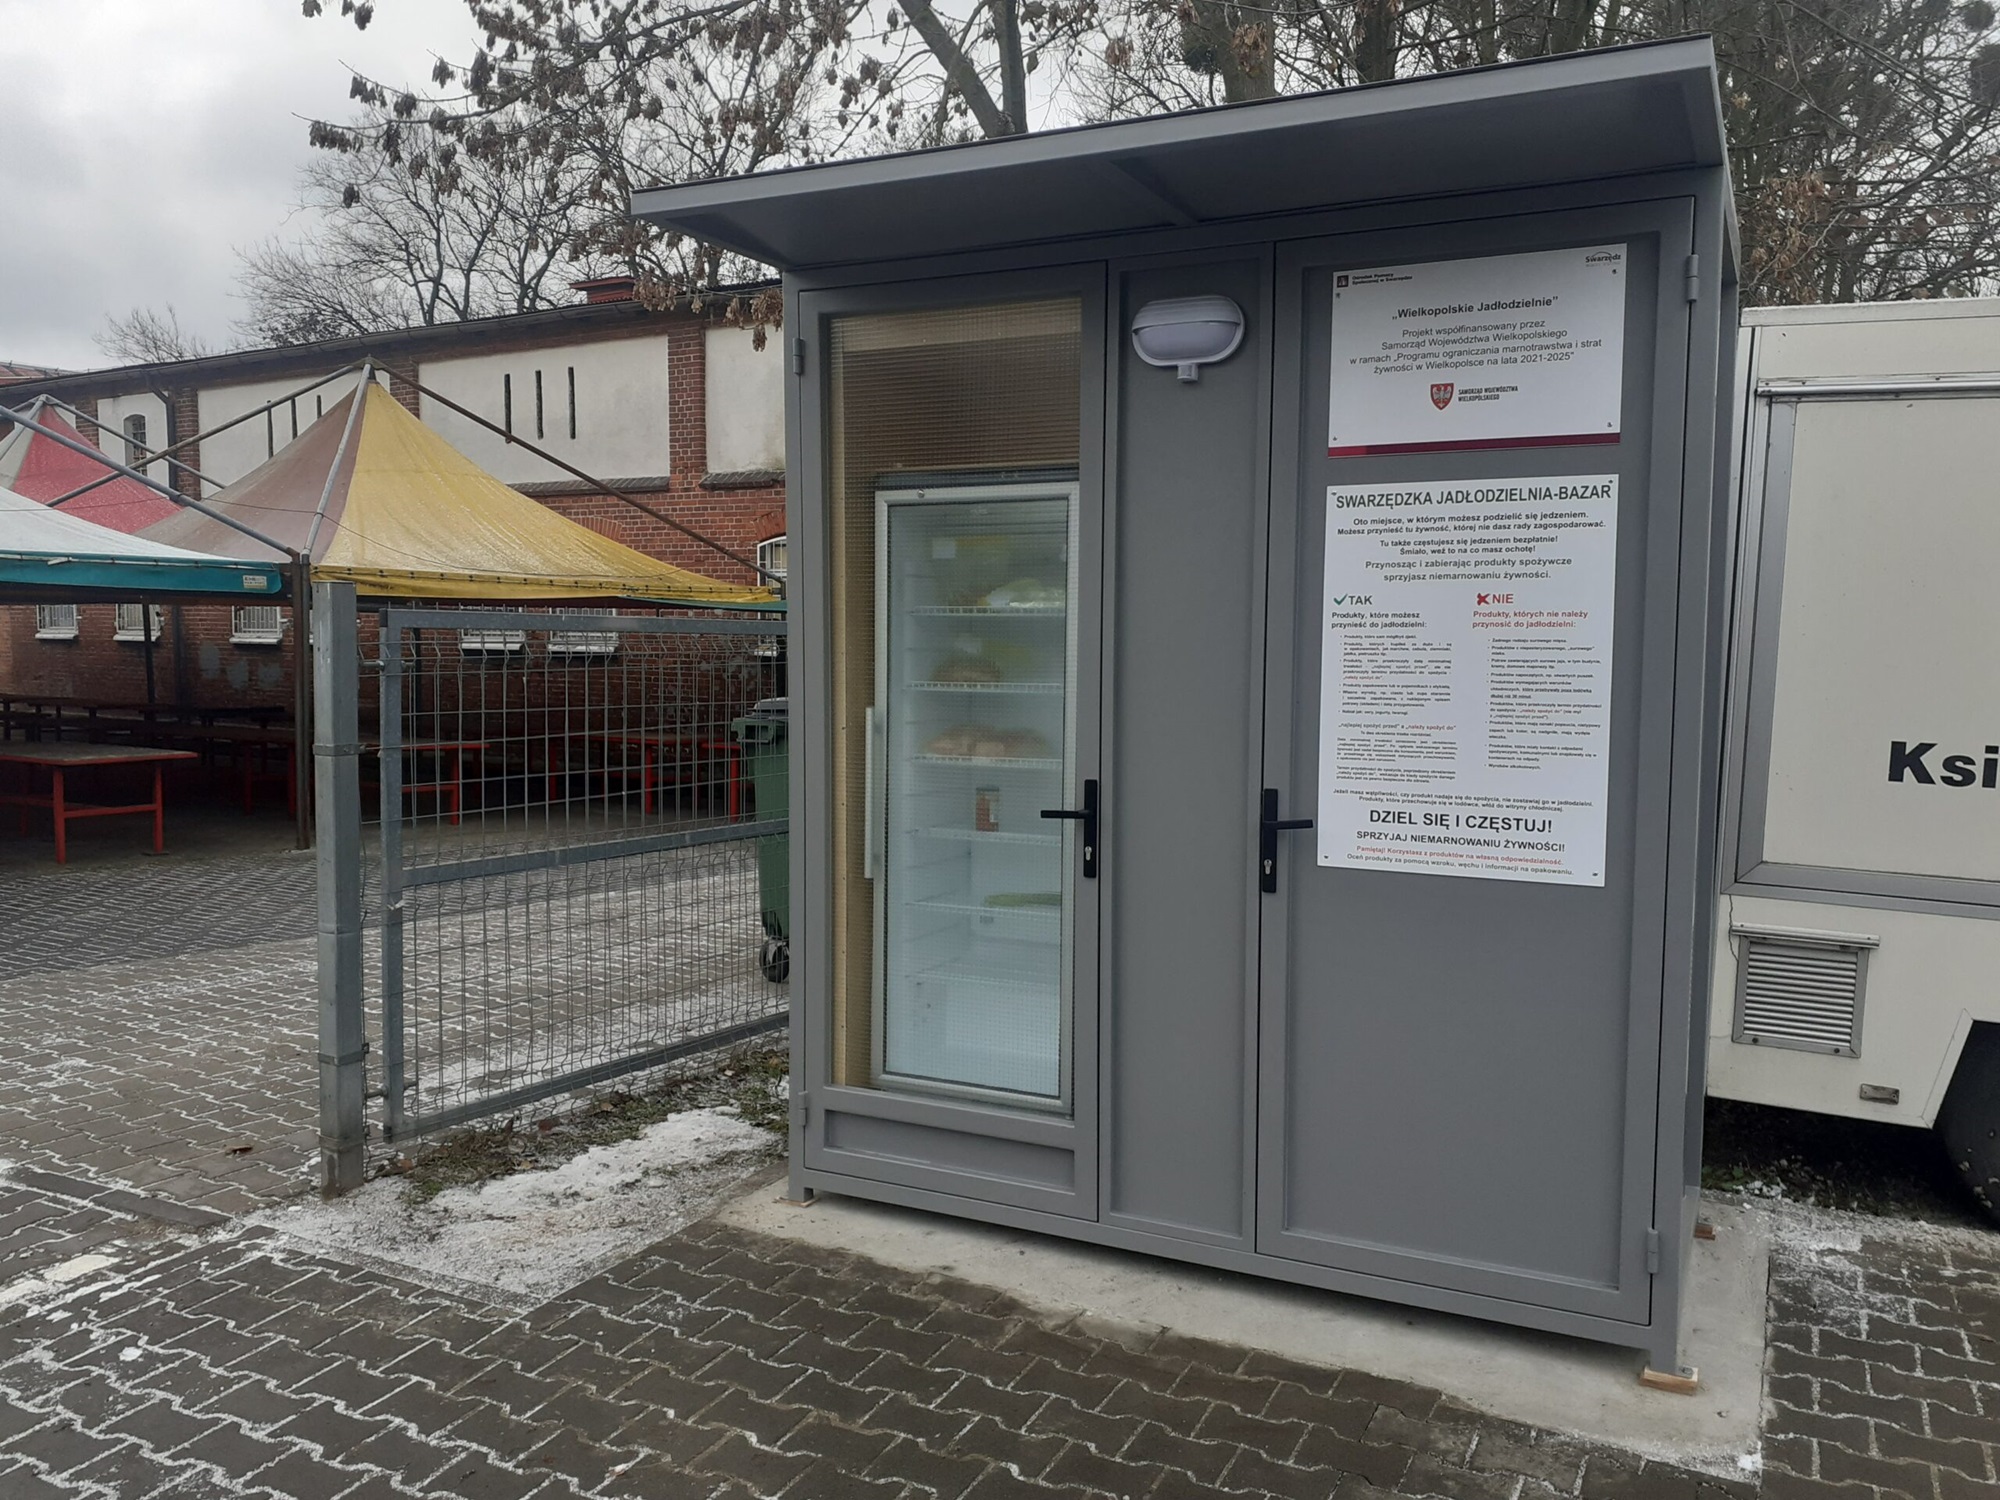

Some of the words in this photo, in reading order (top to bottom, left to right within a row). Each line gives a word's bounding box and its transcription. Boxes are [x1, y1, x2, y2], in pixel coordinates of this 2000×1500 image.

[1585, 252, 1621, 263] Swarzędz
[1477, 296, 1558, 311] Jadłodzielnie”
[1402, 327, 1433, 338] Projekt
[1435, 322, 1519, 335] współfinansowany
[1519, 320, 1546, 330] przez
[1382, 338, 1426, 350] Samorząd
[1428, 333, 1490, 347] Województwa
[1492, 329, 1567, 341] Wielkopolskiego
[1359, 354, 1391, 364] ramach
[1442, 346, 1499, 359] ograniczania
[1502, 342, 1573, 354] marnotrawstwa
[1575, 340, 1578, 348] i
[1580, 339, 1602, 348] strat
[1374, 362, 1413, 374] żywności
[1425, 357, 1484, 369] Wielkopolsce
[1485, 357, 1498, 365] na
[1500, 354, 1519, 364] lata
[1336, 492, 1433, 509] SWARZĘDZKA
[1436, 484, 1611, 504] JADŁODZIELNIA-BAZAR
[1370, 517, 1405, 526] miejsce,
[1416, 516, 1446, 524] którym
[1448, 514, 1481, 524] możesz
[1483, 513, 1522, 522] podzielić
[1525, 512, 1538, 521] się
[1539, 511, 1589, 521] jedzeniem.
[1366, 526, 1403, 535] przynieść
[1415, 525, 1451, 534] żywność,
[1453, 524, 1476, 532] której
[1513, 522, 1532, 531] rady
[1533, 520, 1606, 530] zagospodarować.
[1380, 539, 1389, 547] Tu
[1391, 539, 1411, 548] także
[1413, 538, 1454, 547] częstujesz
[1456, 538, 1468, 546] się
[1469, 537, 1511, 546] jedzeniem
[1513, 535, 1558, 544] bezpłatnie!
[1400, 547, 1428, 555] Śmiało,
[1505, 545, 1536, 553] ochotę!
[1365, 561, 1417, 570] Przynosząc
[1419, 559, 1422, 567] i
[1424, 559, 1471, 568] zabierając
[1474, 558, 1516, 568] produkty
[1519, 557, 1572, 567] spożywcze
[1384, 572, 1426, 582] sprzyjasz
[1429, 570, 1501, 580] niemarnowaniu
[1503, 570, 1551, 581] żywności.
[1349, 595, 1372, 605] TAK
[1492, 593, 1514, 604] NIE
[1332, 612, 1367, 620] Produkty,
[1473, 610, 1511, 619] Produkty,
[1513, 610, 1544, 619] których
[1561, 610, 1588, 619] należy
[1331, 621, 1367, 629] przynieść
[1380, 621, 1427, 629] jadłodzielni:
[1472, 620, 1512, 629] przynosić
[1525, 620, 1576, 629] jadłodzielni:
[1370, 809, 1418, 825] DZIEL
[1422, 812, 1450, 829] SIĘ
[1456, 814, 1459, 827] I
[1465, 815, 1552, 832] CZĘSTUJ!
[1356, 830, 1407, 841] SPRZYJAJ
[1410, 834, 1500, 848] NIEMARNOWANIU
[1503, 838, 1565, 852] ŻYWNOŚCI!
[1356, 845, 1386, 854] Pamiętaj!
[1387, 847, 1423, 858] Korzystasz
[1429, 850, 1464, 860] produktów
[1475, 852, 1499, 862] własną
[1500, 854, 1564, 865] odpowiedzialność.
[1347, 853, 1363, 861] Oceń
[1364, 855, 1393, 863] produkty
[1403, 857, 1429, 866] pomocą
[1430, 860, 1456, 868] wzroku,
[1457, 861, 1480, 869] węchu
[1485, 863, 1519, 872] informacji
[1530, 865, 1574, 875] opakowaniu.
